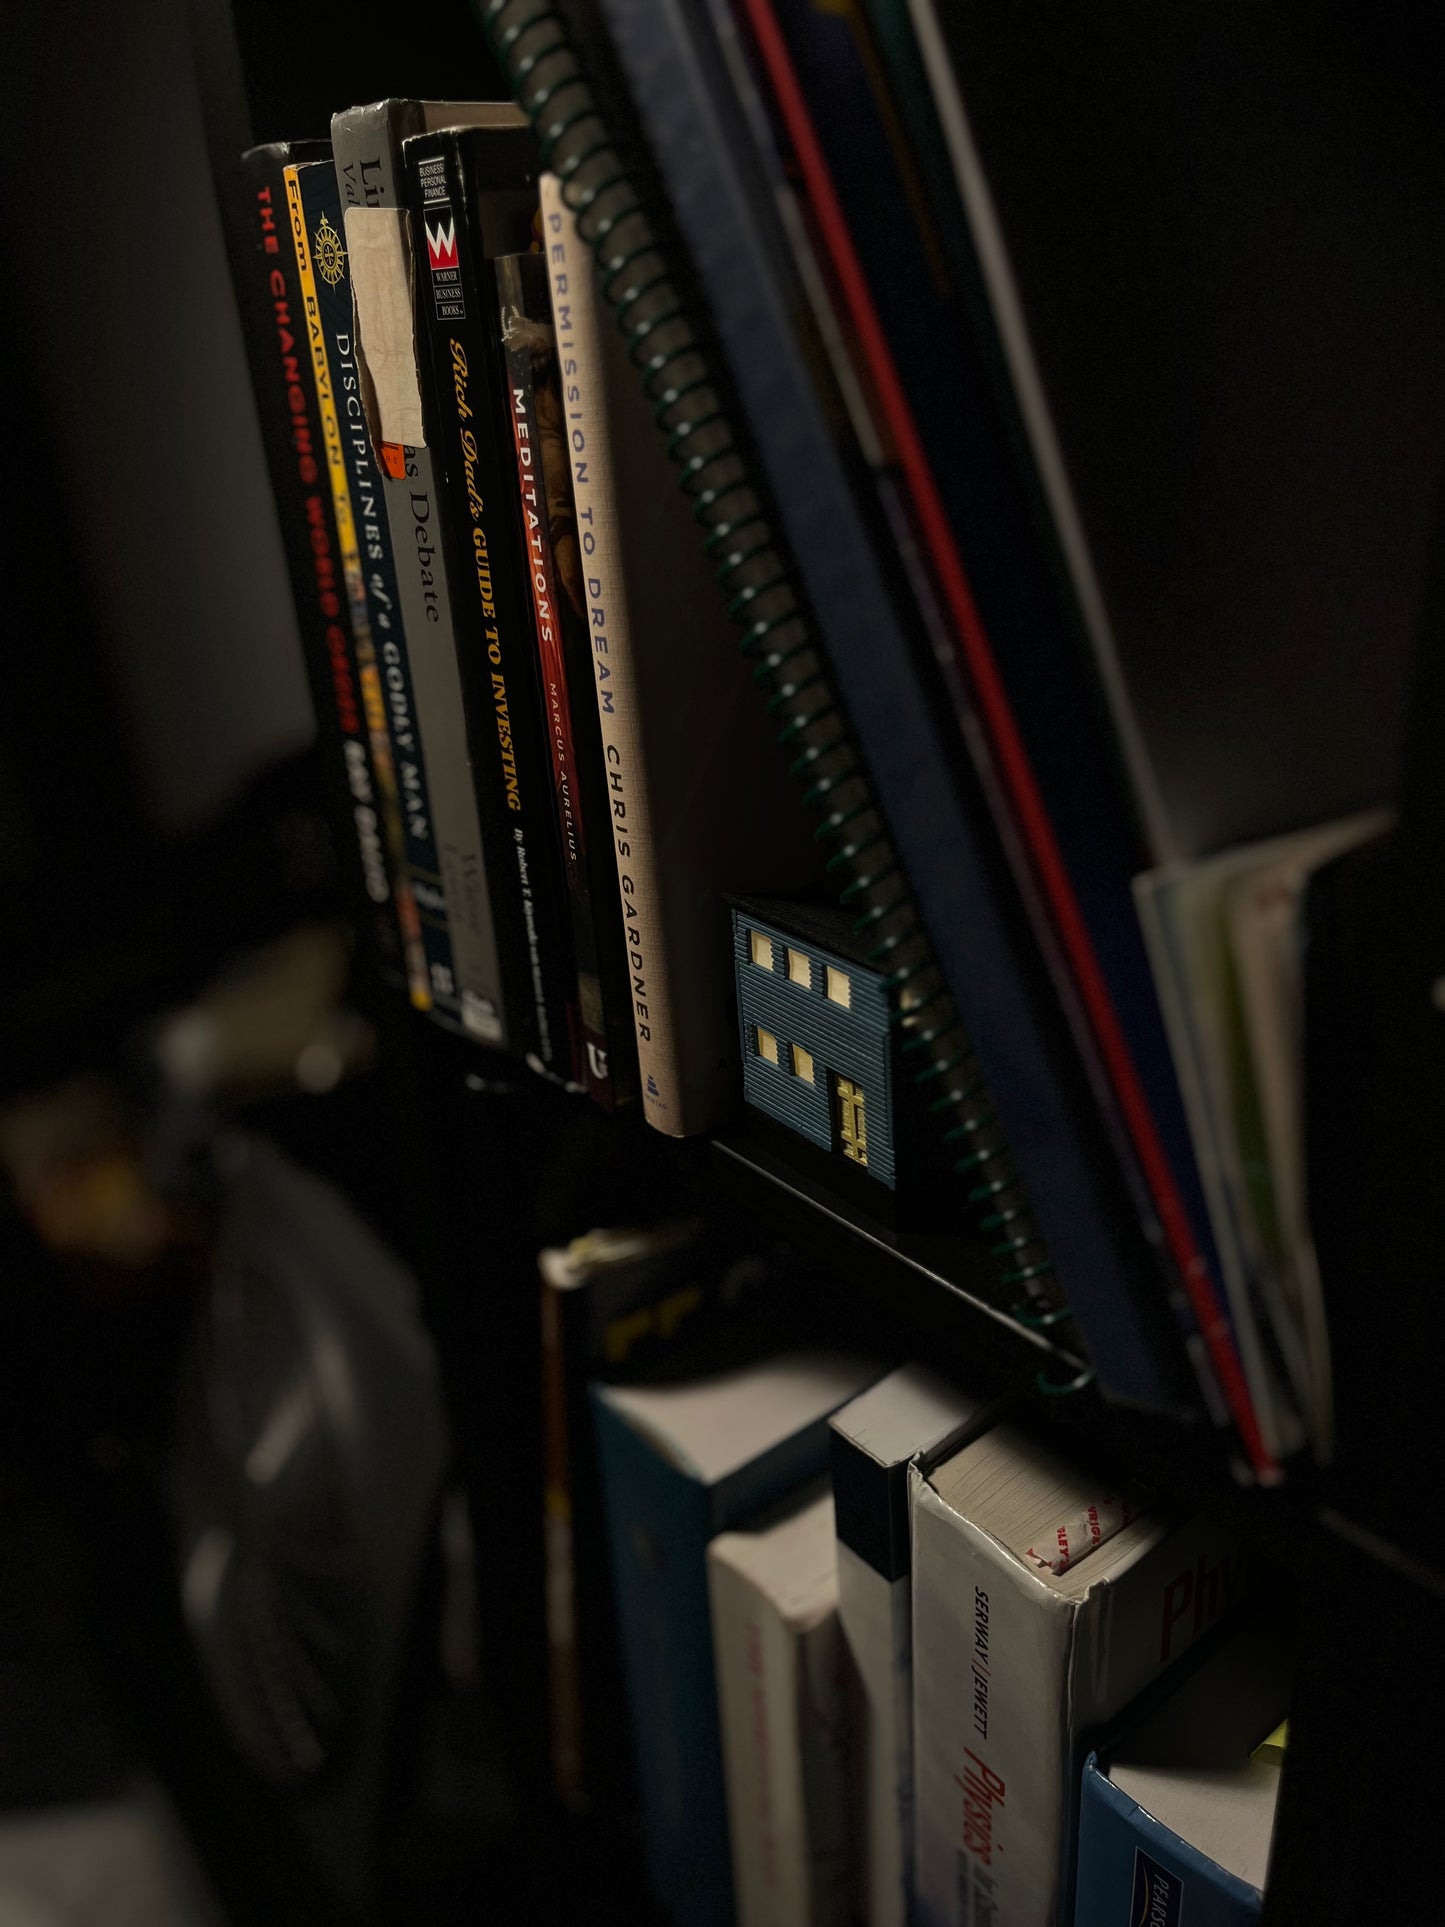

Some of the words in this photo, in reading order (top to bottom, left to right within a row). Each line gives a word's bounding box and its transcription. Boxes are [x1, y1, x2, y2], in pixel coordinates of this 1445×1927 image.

[420, 174, 447, 189] PERSONAL
[424, 186, 447, 199] FINANCE
[435, 287, 462, 300] BUSINESS
[436, 270, 458, 282] WARNER
[256, 185, 280, 255] THE
[268, 268, 318, 485] CHANGING
[306, 296, 342, 466] BABYLON
[449, 336, 474, 423] Rich
[460, 427, 484, 522] Dad's
[511, 388, 553, 644] MEDITATIONS
[548, 213, 579, 484] PERMISSION
[580, 506, 596, 557] TO
[588, 577, 615, 715] DREAM
[336, 332, 384, 561] DISCIPLINES
[382, 640, 416, 753] GODLY
[410, 490, 440, 624] Debate
[472, 526, 497, 619] GUIDE
[484, 625, 502, 666] TO
[490, 671, 522, 812] INVESTING
[549, 682, 566, 763] MARCUS
[560, 770, 578, 862] AURELIUS
[606, 743, 631, 859] CHRIS
[621, 873, 652, 1043] GARDNER
[974, 1585, 990, 1665] SERWAY
[970, 1664, 989, 1740] JEWETT
[953, 1747, 1006, 1867] Physics
